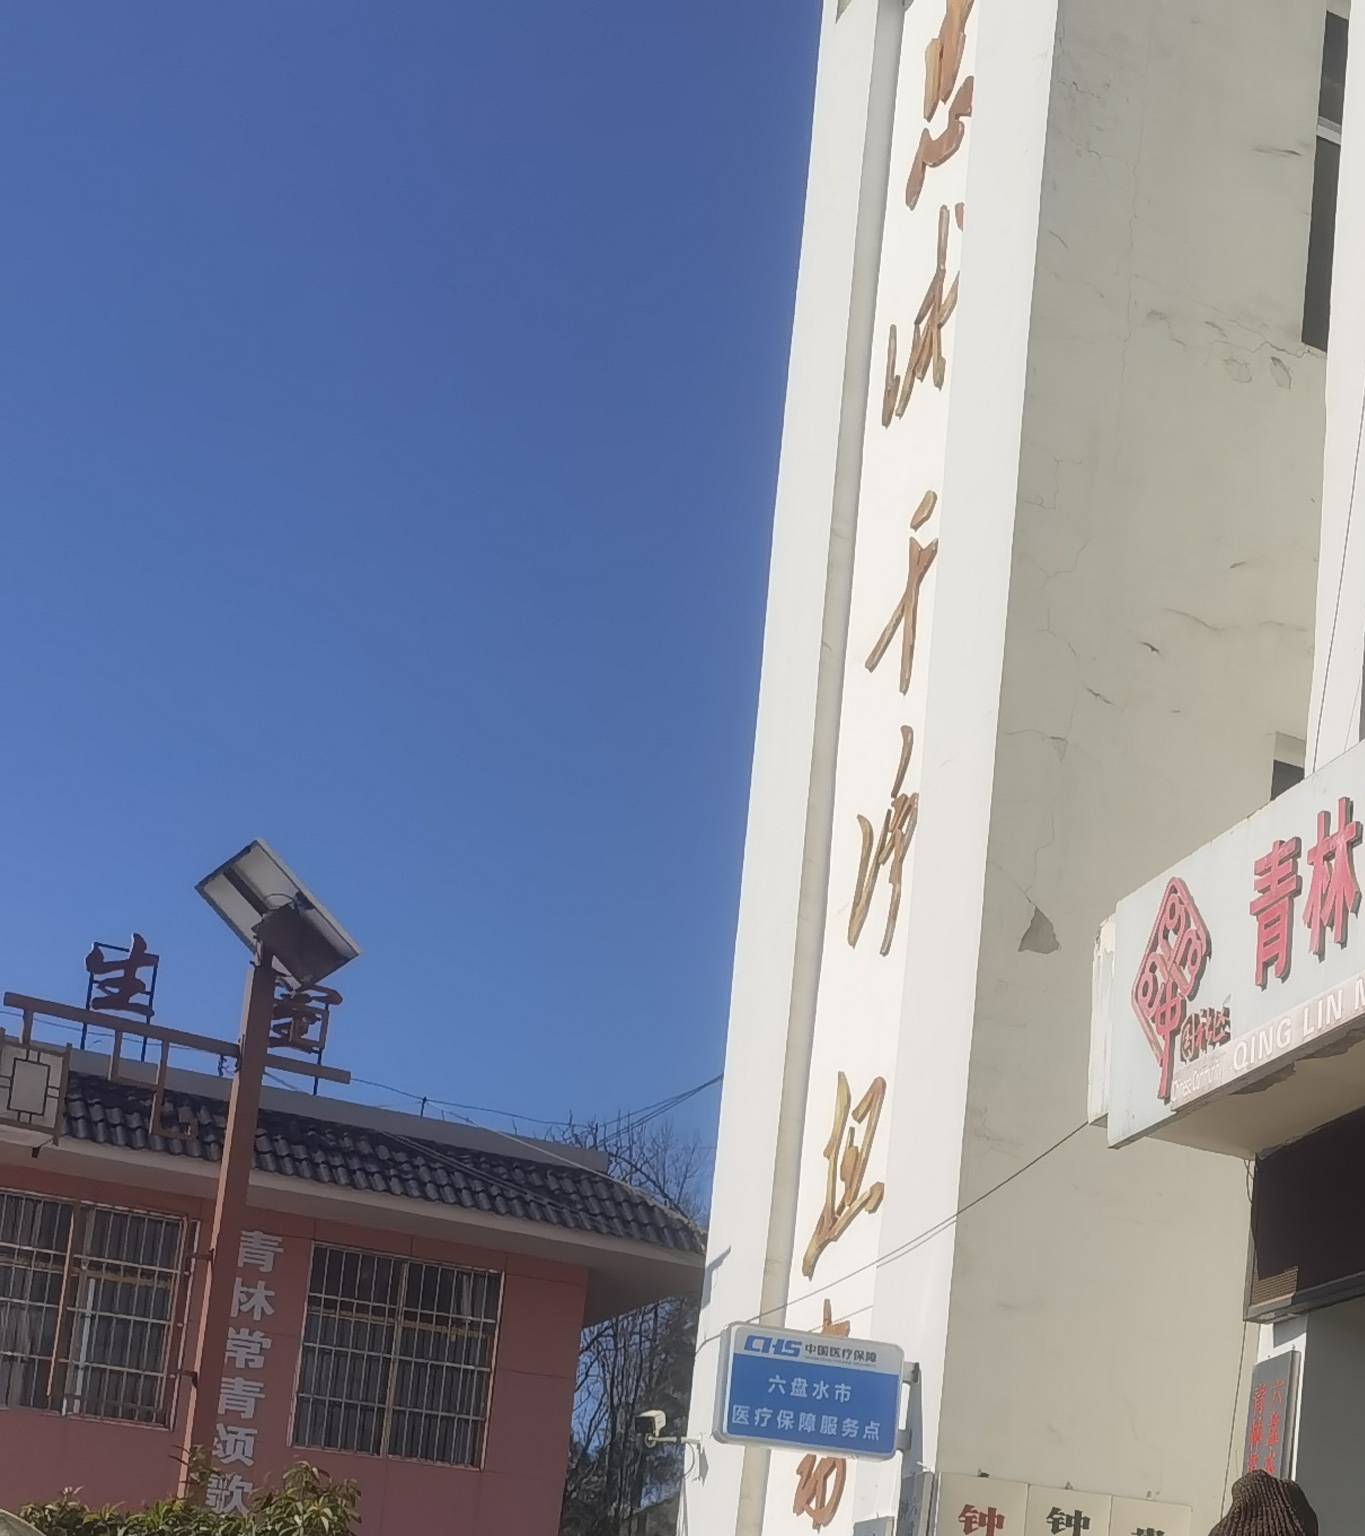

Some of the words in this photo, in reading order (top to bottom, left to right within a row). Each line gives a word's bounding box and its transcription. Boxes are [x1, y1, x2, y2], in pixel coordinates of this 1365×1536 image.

[1232, 1022, 1294, 1072] QING
[1302, 990, 1343, 1036] LIN
[744, 1335, 803, 1358] CHS
[805, 1343, 877, 1363] 中国医疗保障
[768, 1375, 852, 1403] 六盘水市
[731, 1404, 880, 1441] 医疗保障服务点
